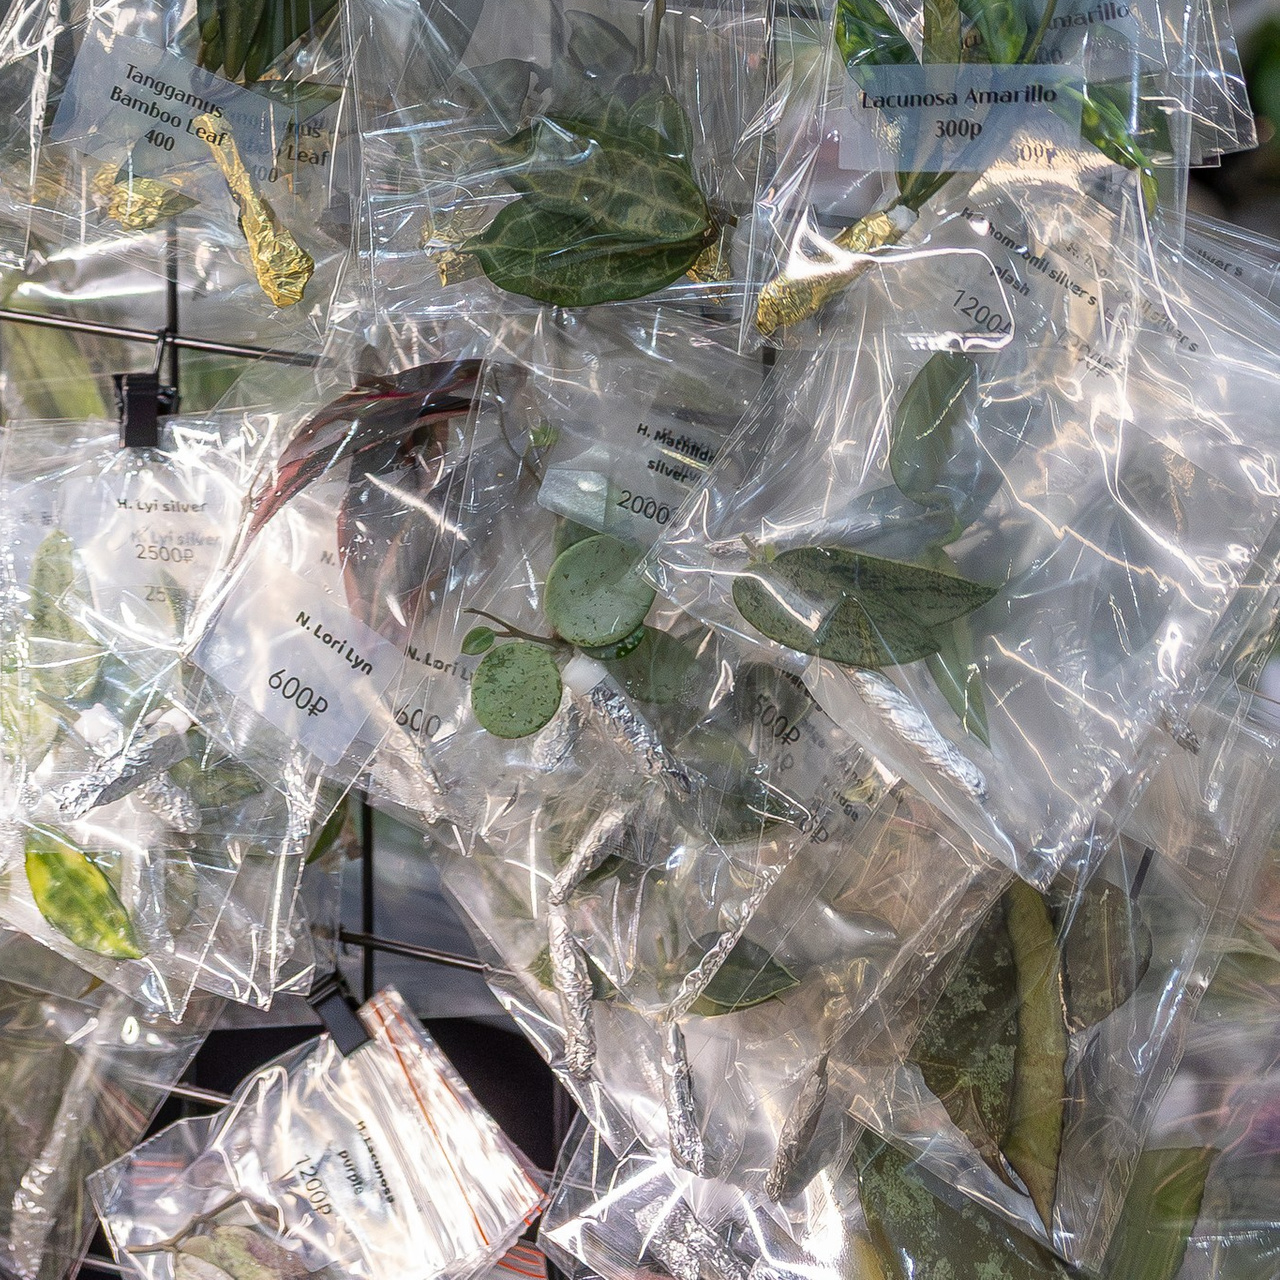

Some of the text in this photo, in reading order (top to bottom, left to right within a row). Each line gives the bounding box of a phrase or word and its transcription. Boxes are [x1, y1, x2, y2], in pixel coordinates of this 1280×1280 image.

[125, 63, 225, 119] Tanggamus
[861, 83, 1058, 110] Lacunosa Amarillo
[110, 85, 182, 128] Bamboo
[186, 118, 229, 148] Leaf
[934, 118, 983, 140] 300p
[144, 128, 175, 152] 400
[637, 423, 651, 438] H.
[648, 459, 689, 483] silver
[163, 500, 208, 513] silver
[296, 611, 374, 676] N. Lori Lyn
[268, 668, 329, 717] 600₽
[337, 1149, 364, 1196] purple
